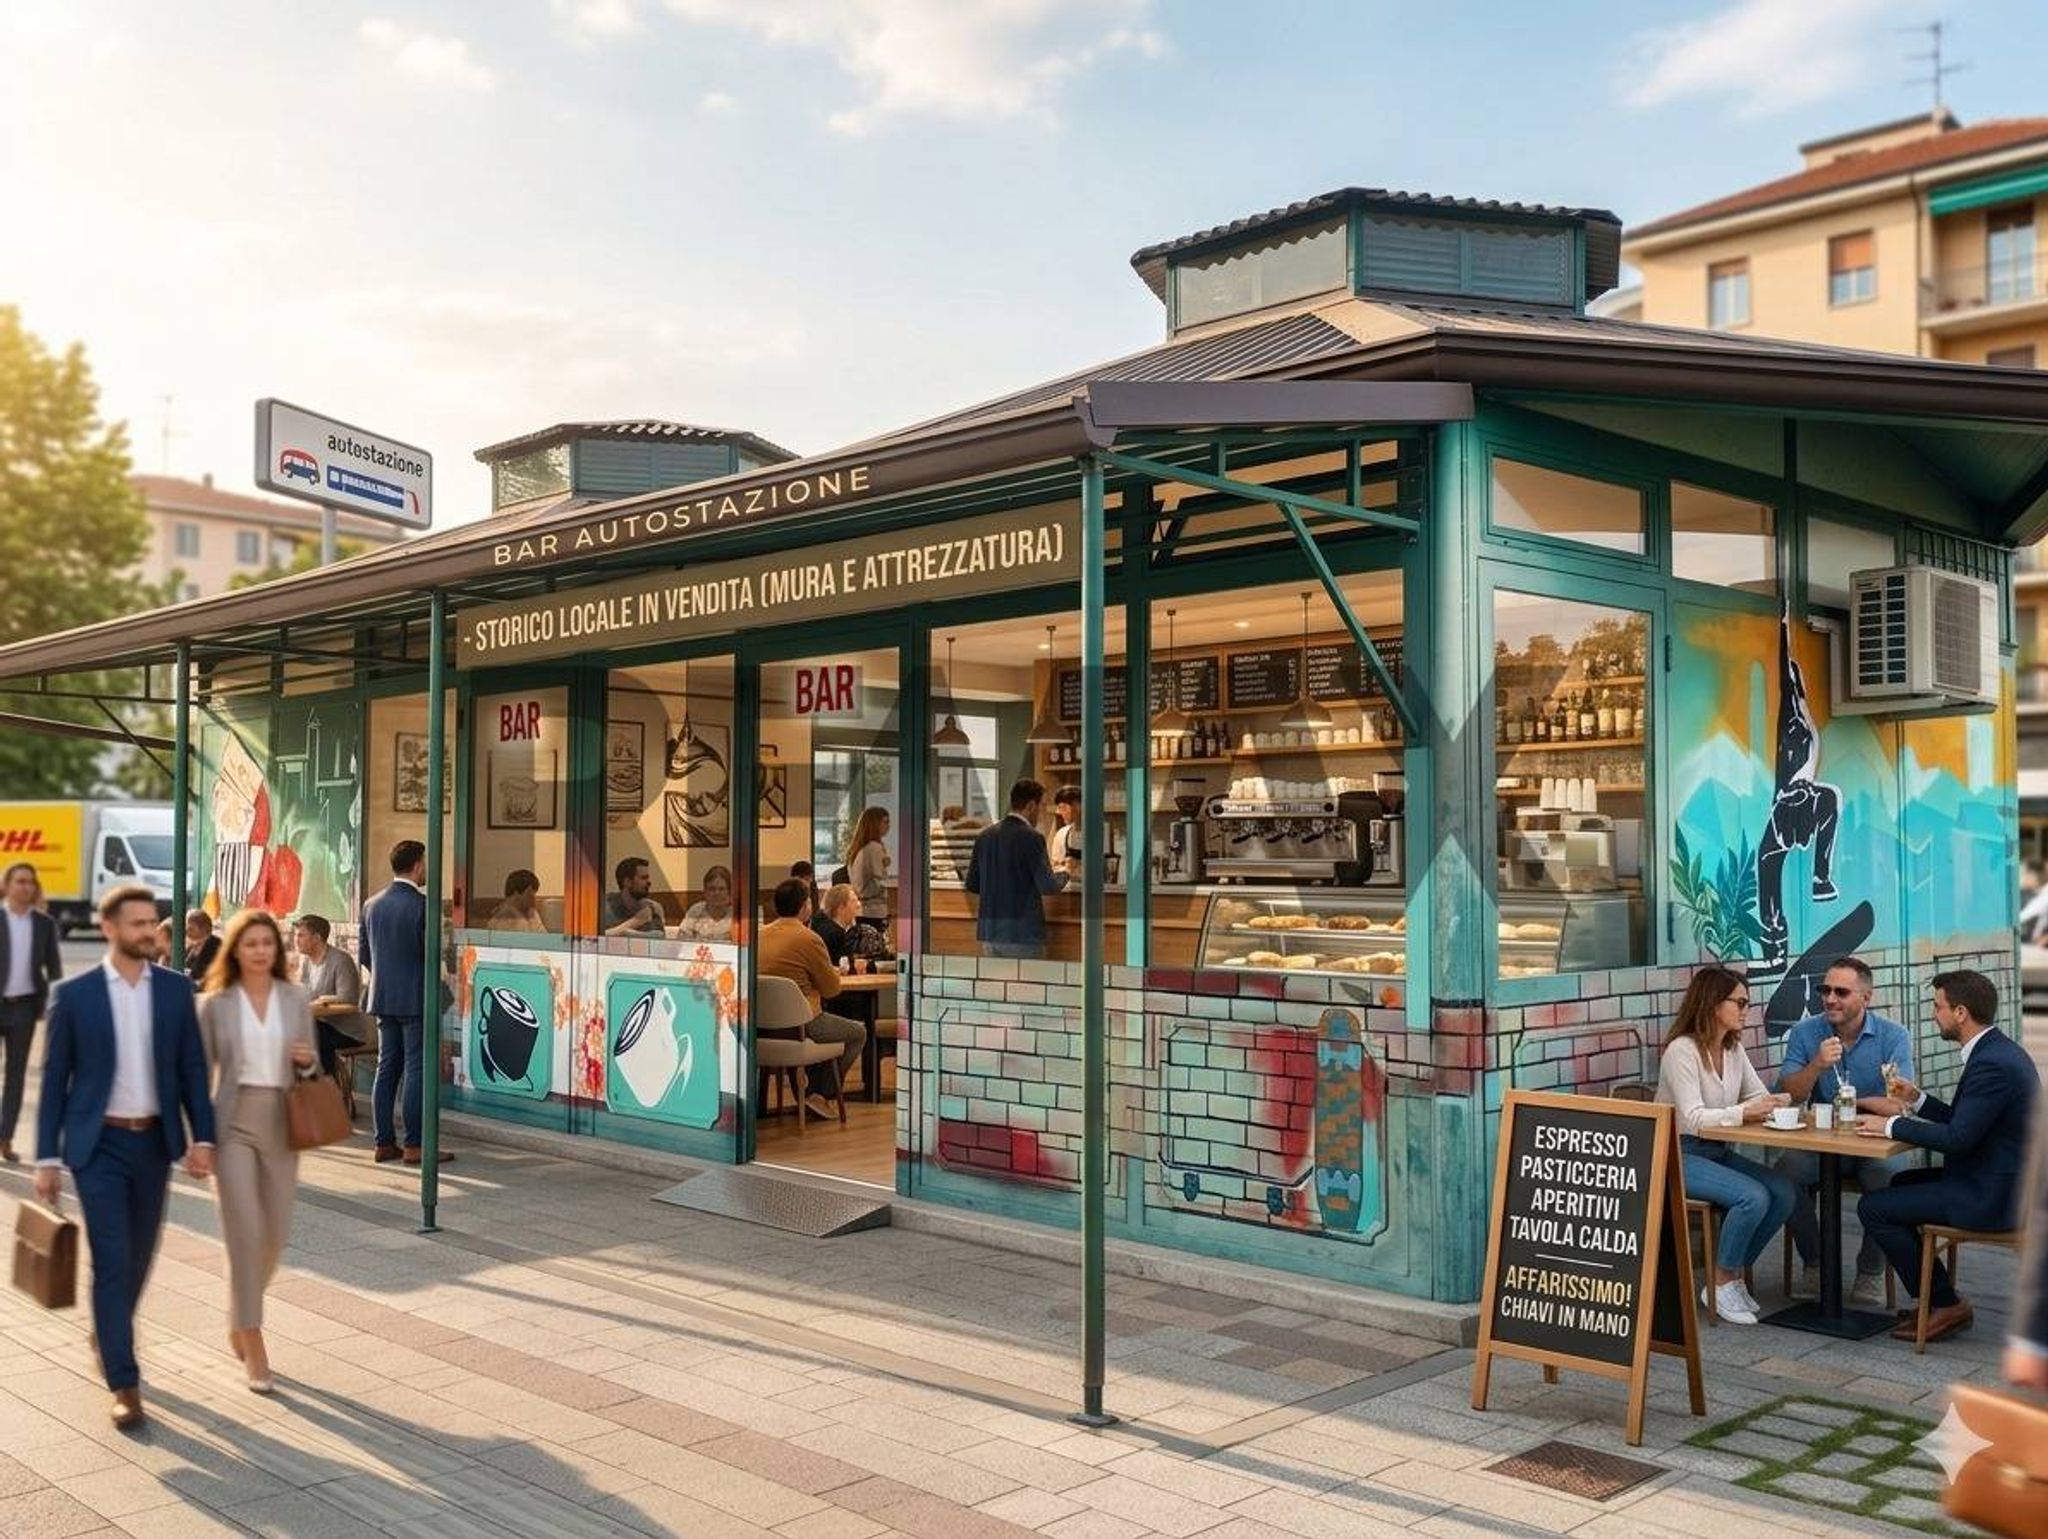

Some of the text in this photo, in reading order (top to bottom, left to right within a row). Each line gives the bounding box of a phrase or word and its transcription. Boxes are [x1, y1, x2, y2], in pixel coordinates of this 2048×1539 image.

[328, 434, 423, 477] autostazione
[494, 466, 870, 566] BAR AUTOSTAZIONE
[476, 610, 554, 652] STORICO
[560, 597, 633, 639] LOCALE
[639, 592, 659, 624] IN
[664, 577, 754, 621] VENDITA
[760, 563, 836, 607] (MURA
[843, 559, 857, 593] E
[863, 523, 1063, 590] ATTREZZATURA)
[795, 664, 854, 714] BAR
[499, 701, 540, 742] BAR
[0, 830, 47, 852] HL
[1535, 1126, 1628, 1158] ESPRESSO
[1520, 1155, 1637, 1192] PASTICCERIA
[1531, 1188, 1620, 1221] APERITIVI
[1510, 1215, 1638, 1256] TAVOLA CALDA
[1505, 1265, 1632, 1307] AFFARISSIMO!
[1501, 1295, 1630, 1337] CHIAVI IN MANO
